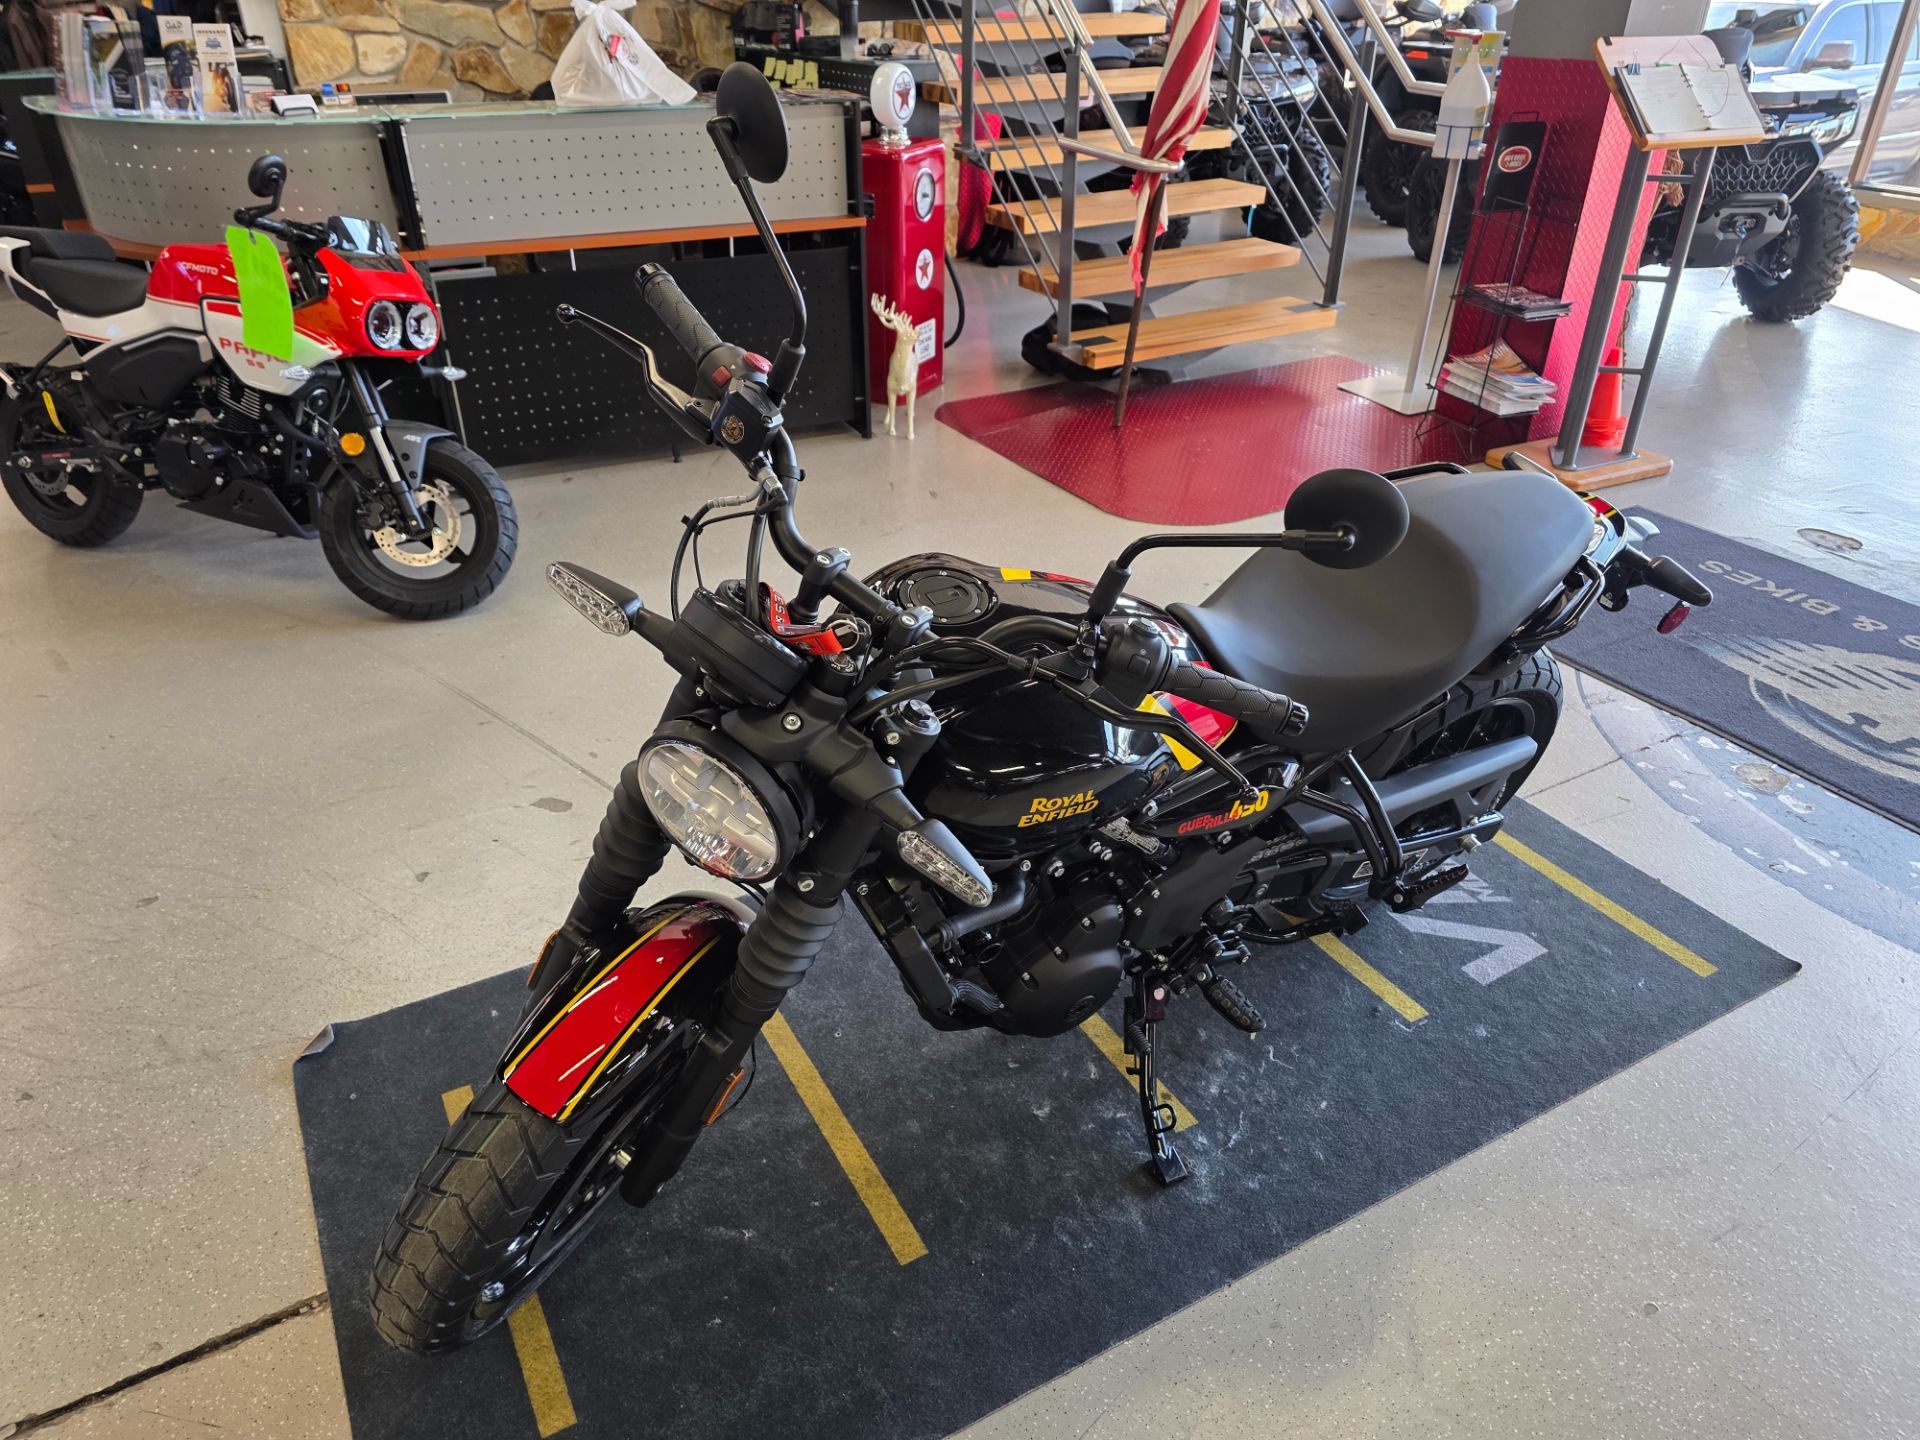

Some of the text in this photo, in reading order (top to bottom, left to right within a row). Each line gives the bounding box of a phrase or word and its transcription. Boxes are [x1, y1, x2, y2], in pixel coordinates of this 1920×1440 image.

[181, 261, 219, 276] CFMOTO
[1699, 561, 1888, 633] & BIKES
[1030, 790, 1095, 813] ROYAL
[1016, 799, 1100, 829] ENFIELD
[1178, 811, 1240, 834] GUERRILLA
